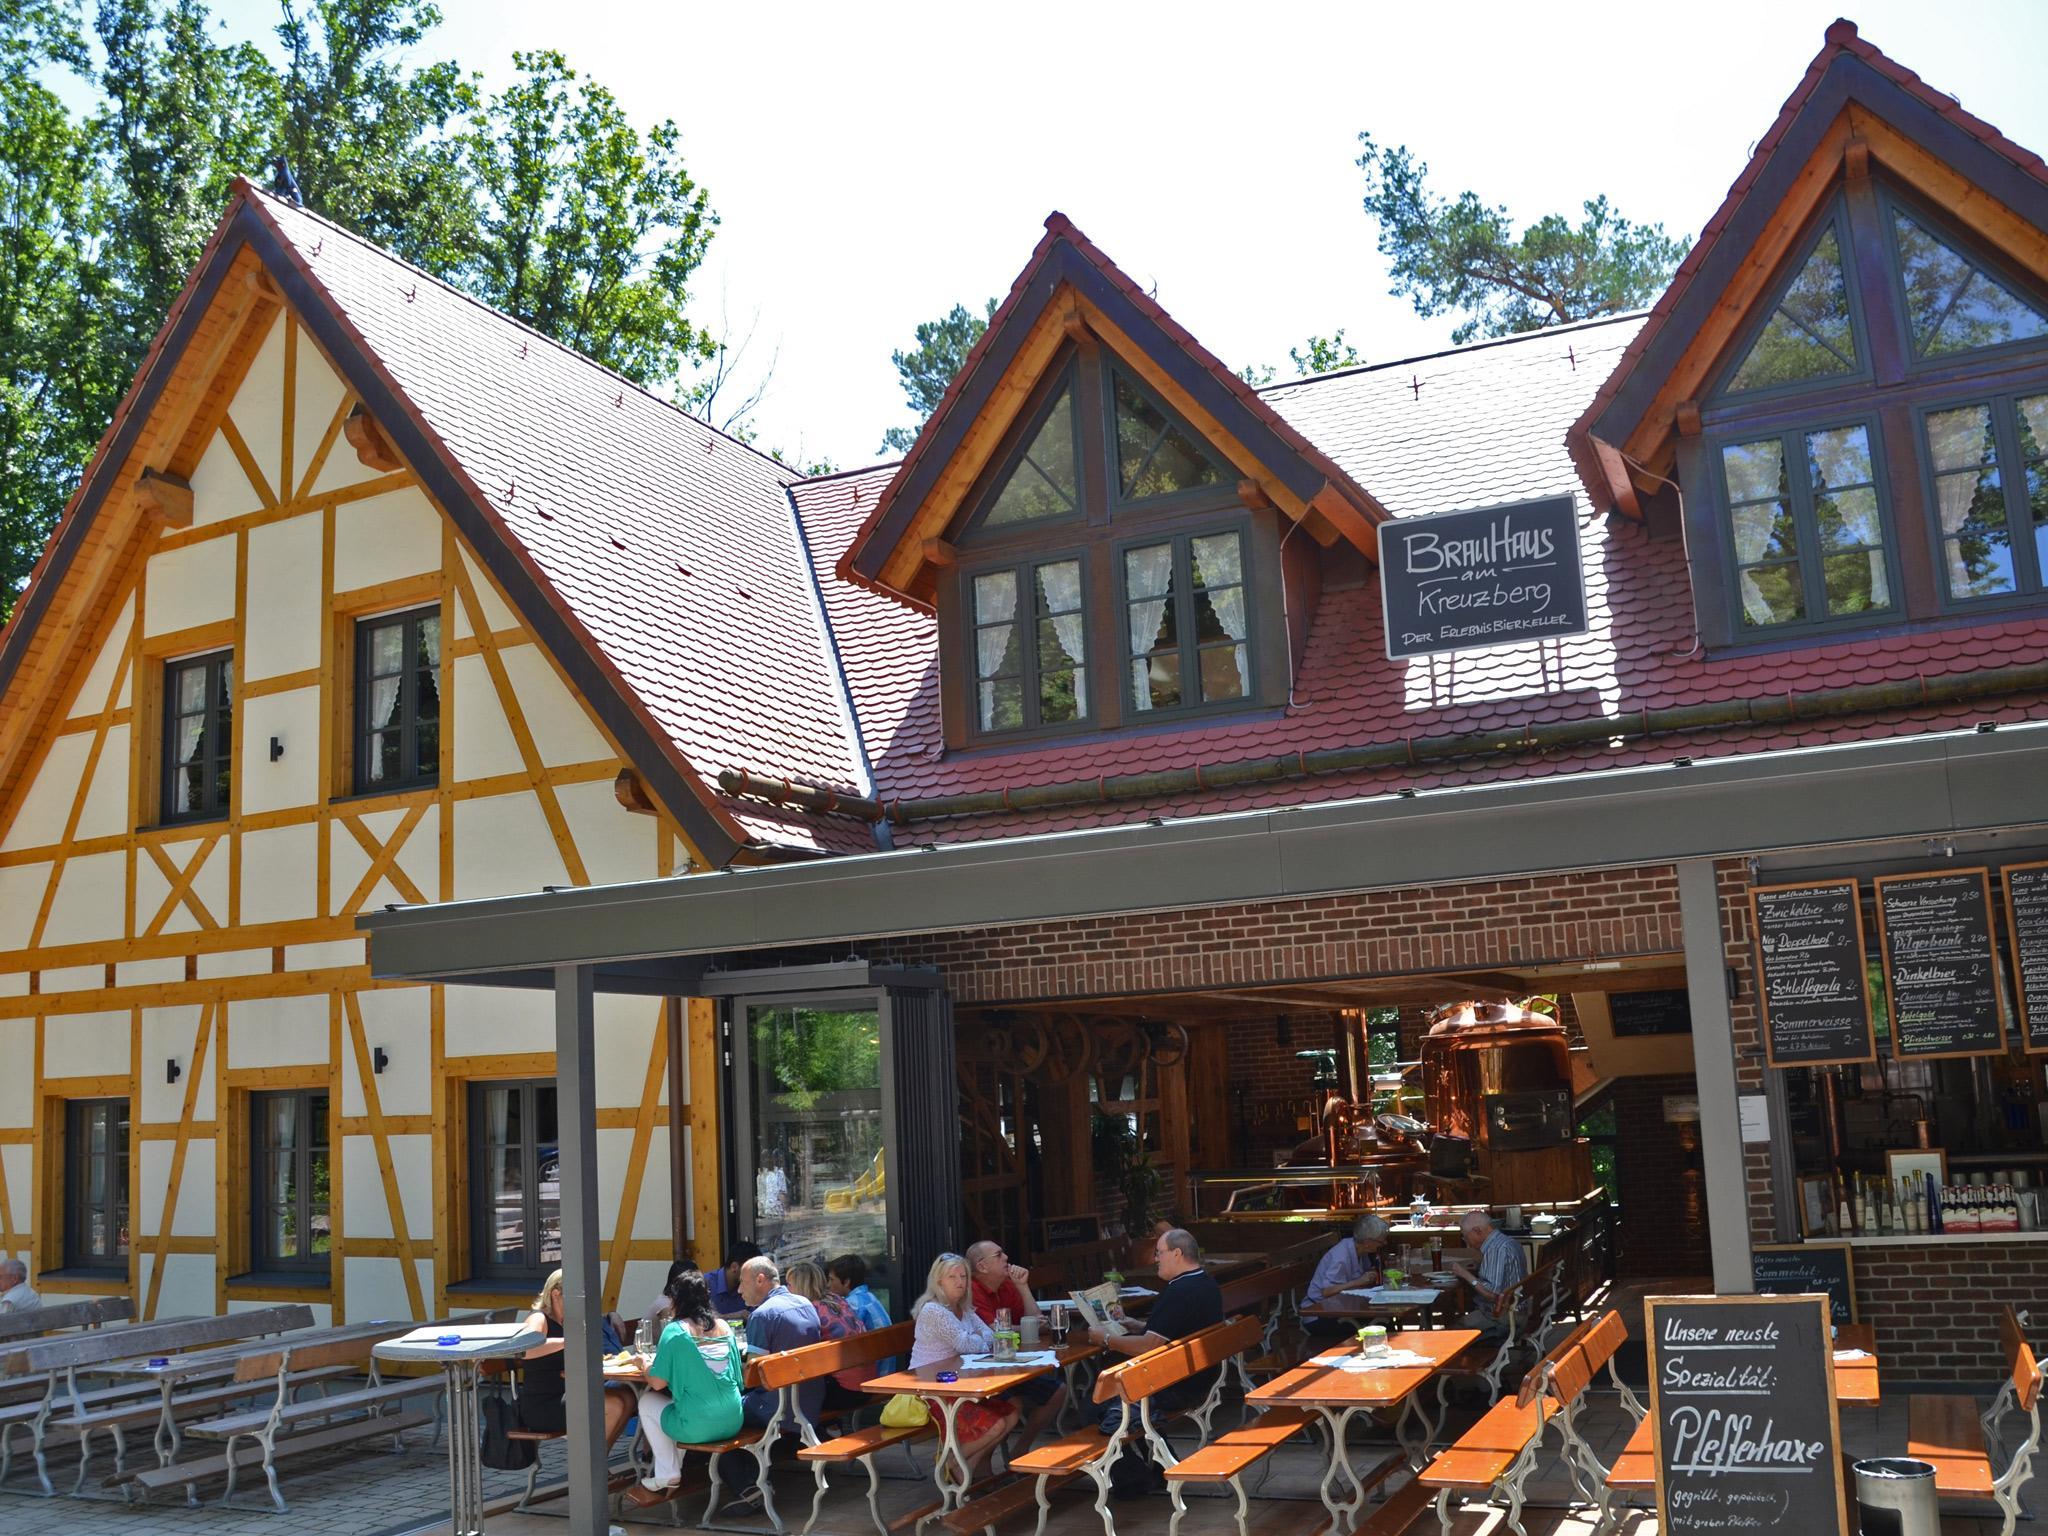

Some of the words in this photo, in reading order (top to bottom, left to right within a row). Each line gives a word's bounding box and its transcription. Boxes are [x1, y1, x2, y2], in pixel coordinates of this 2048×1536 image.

[1461, 569, 1497, 581] am
[1418, 583, 1551, 616] Kreuzberg
[1402, 633, 1433, 646] DER
[1763, 902, 1824, 919] Zwickelbier
[1897, 966, 1956, 981] Dinkelbier
[1775, 1013, 1851, 1030] Sommerweisse
[1664, 1317, 1718, 1342] Unsere
[1725, 1321, 1780, 1342] neuste
[1663, 1356, 1778, 1388] Spezialität:
[1669, 1405, 1824, 1477] Pfefferhaxe
[1673, 1514, 1693, 1526] mit
